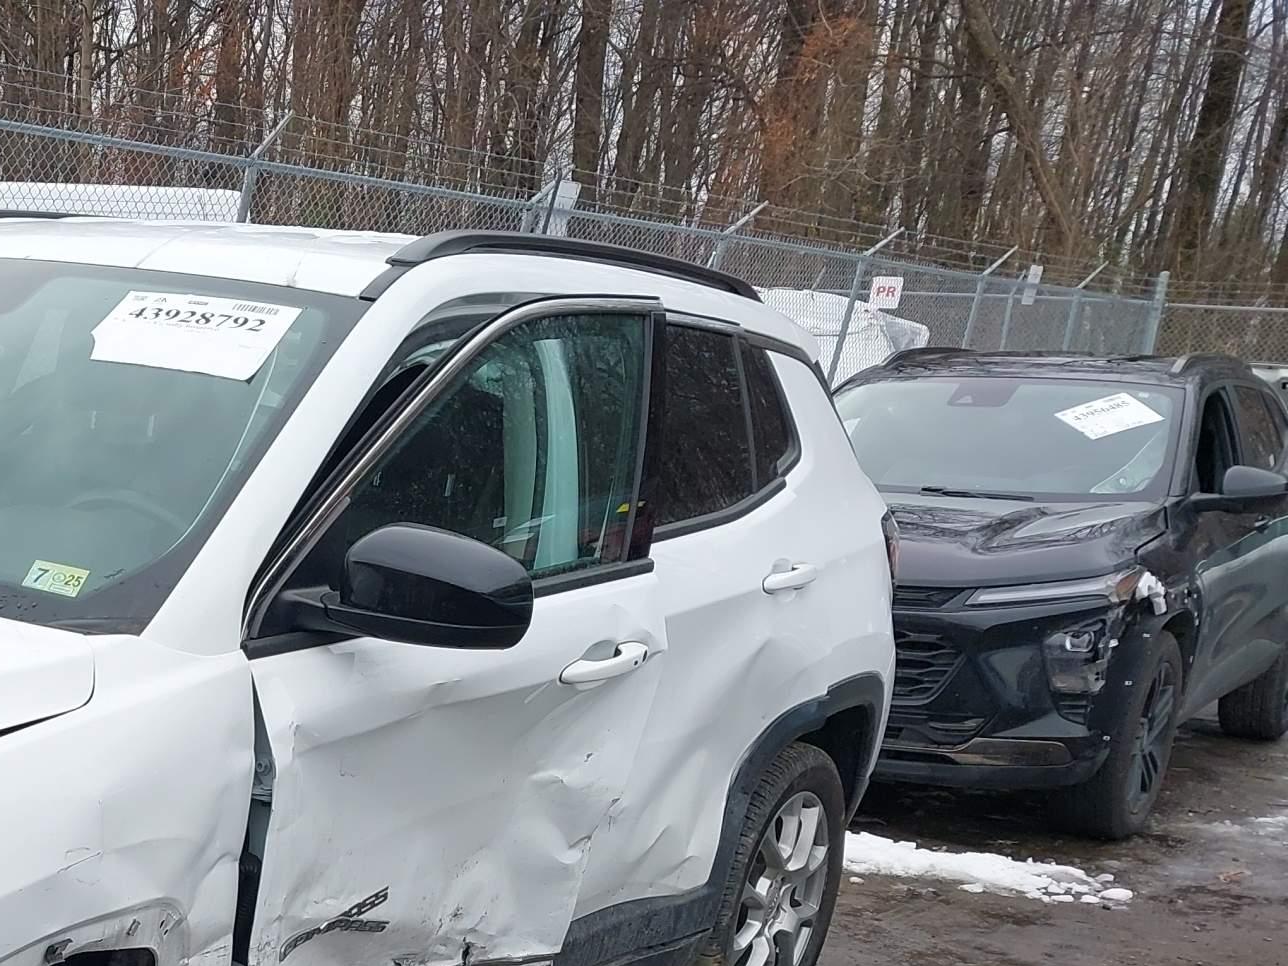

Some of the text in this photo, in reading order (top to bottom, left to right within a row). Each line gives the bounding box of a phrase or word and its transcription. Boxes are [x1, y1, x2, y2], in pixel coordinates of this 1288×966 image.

[875, 286, 896, 297] PR
[128, 306, 266, 332] 43928792
[33, 567, 50, 583] 7
[64, 574, 84, 588] 25
